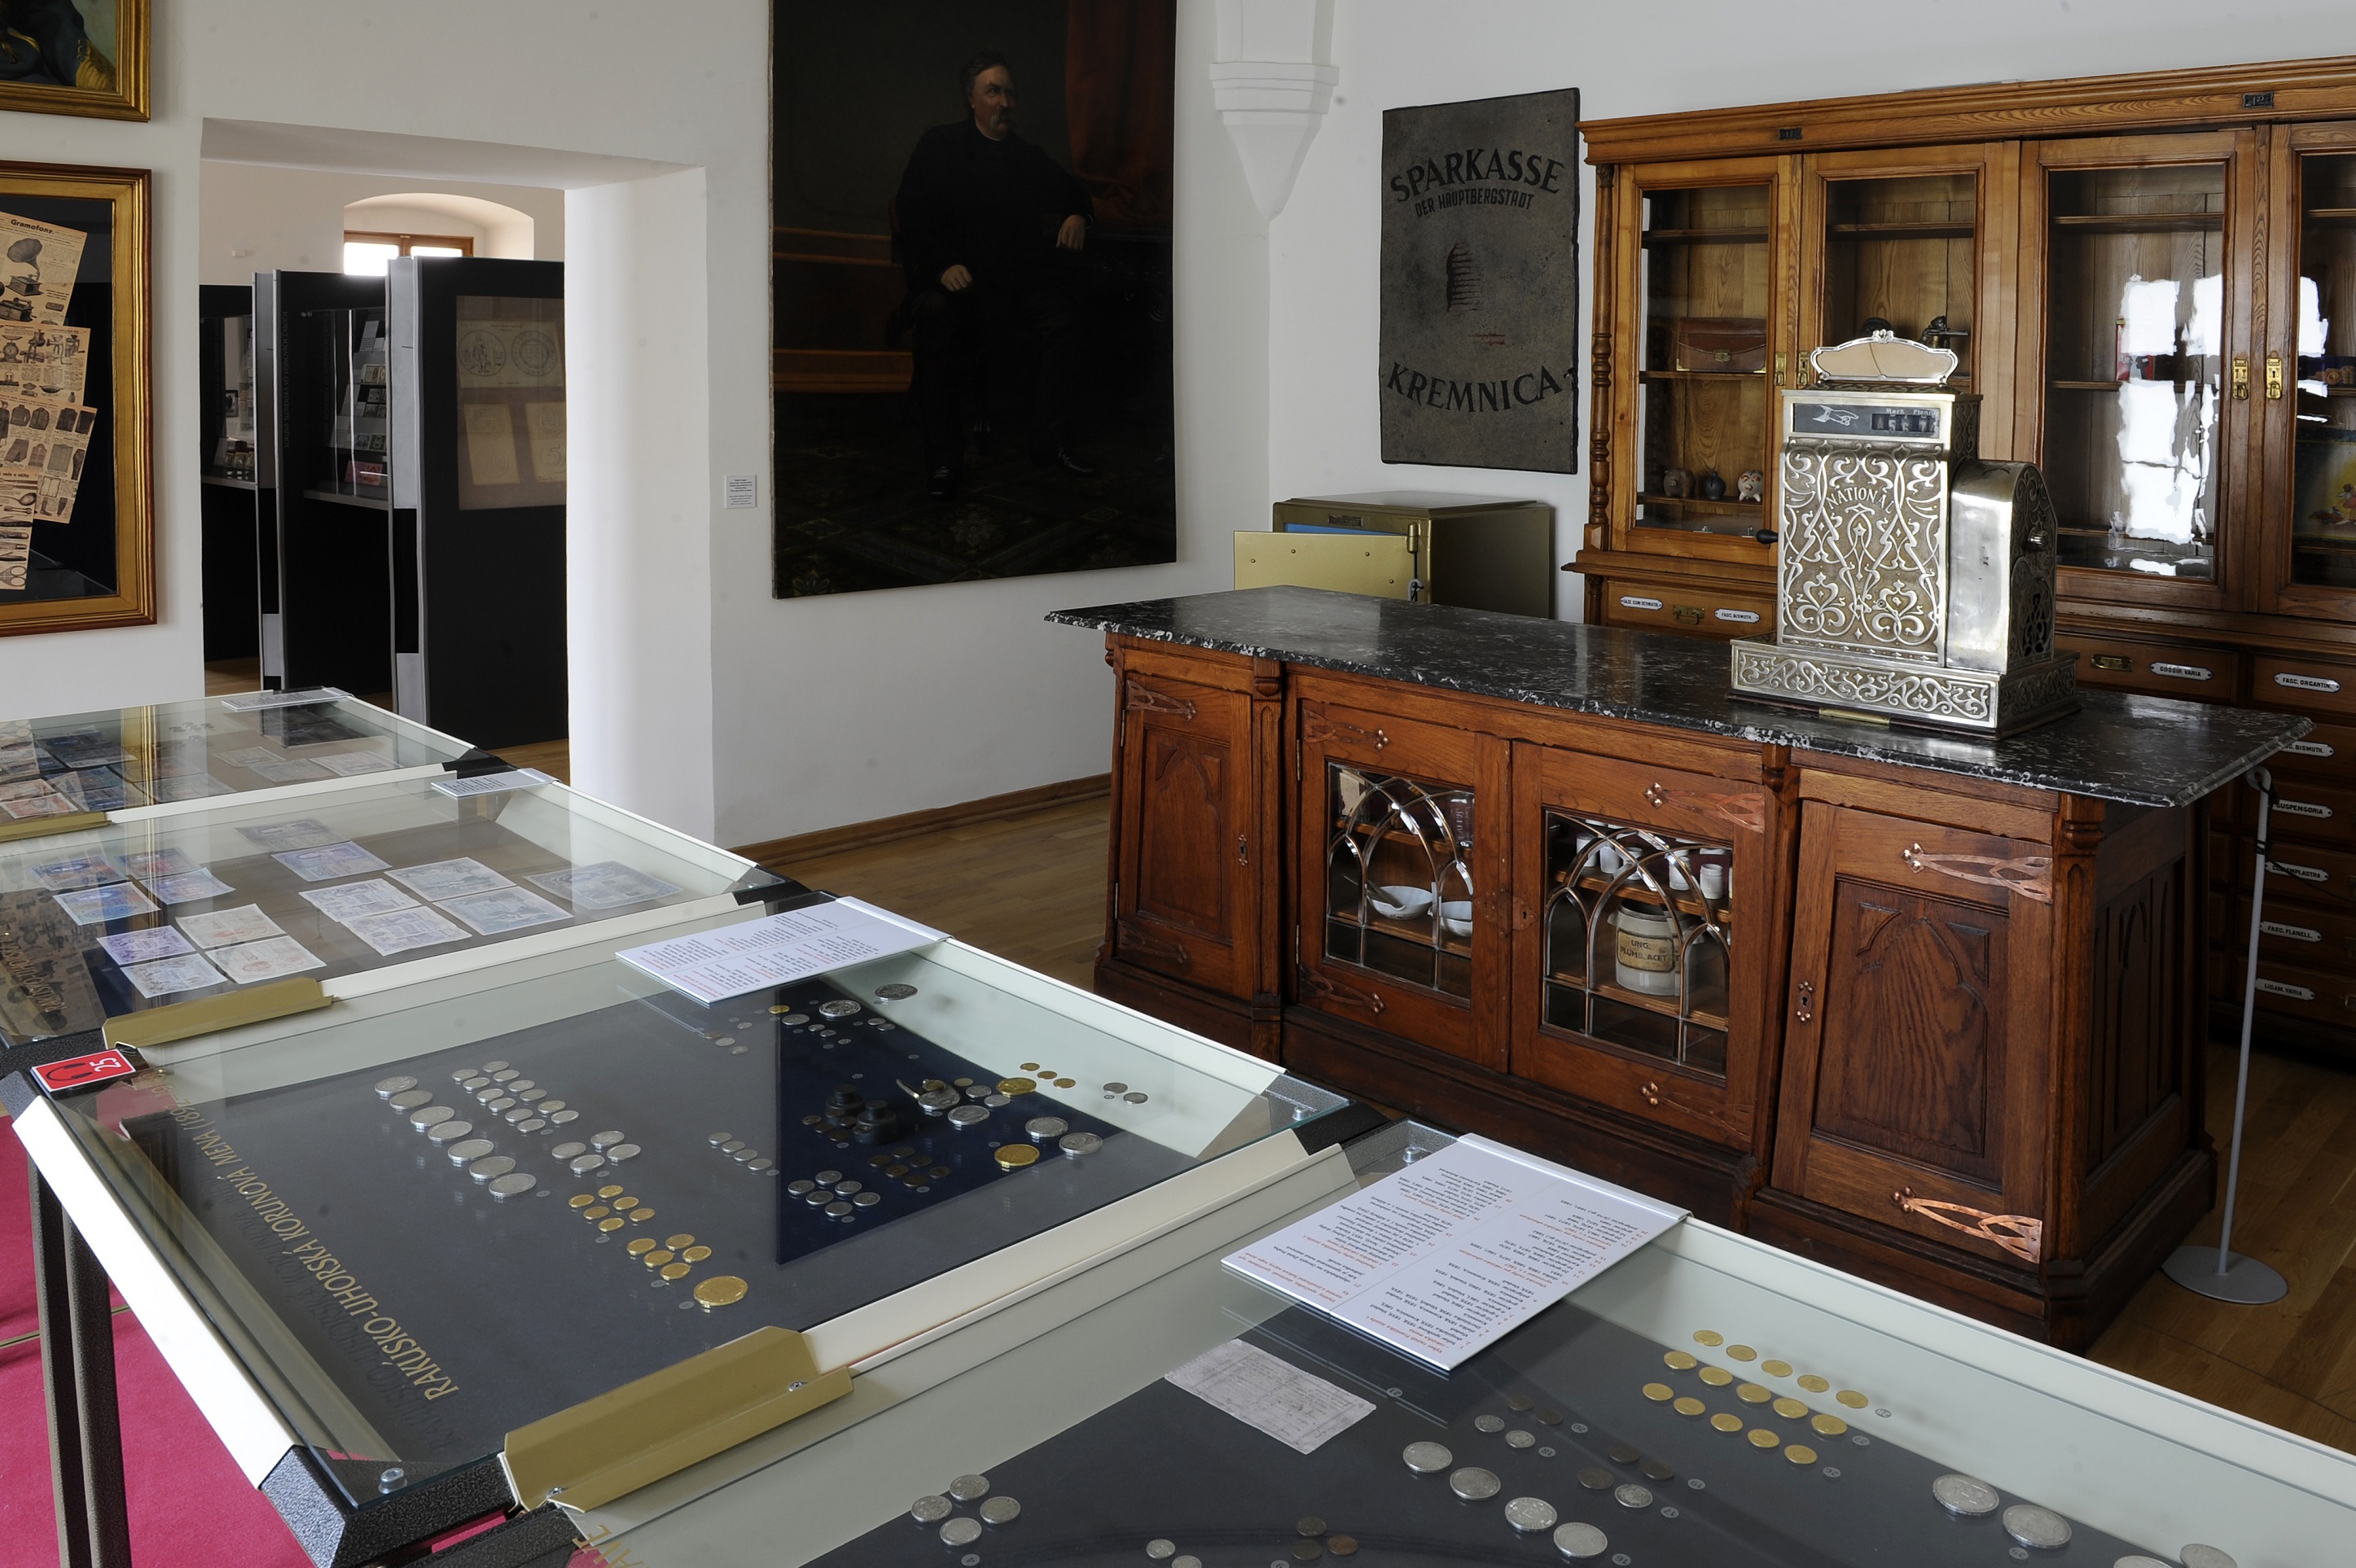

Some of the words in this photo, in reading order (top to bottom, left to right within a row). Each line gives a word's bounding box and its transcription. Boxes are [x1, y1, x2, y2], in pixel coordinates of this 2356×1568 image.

[2253, 96, 2265, 105] 12
[1391, 148, 1564, 203] SPARKASSE
[1415, 195, 1434, 218] DER
[1438, 190, 1534, 210] HAUPTBERGSTADT
[11, 218, 55, 234] Gramofony.
[1387, 362, 1562, 413] KREMNICA
[1825, 486, 1894, 515] NATIONAL
[2160, 666, 2183, 675] GOSSIP.
[2184, 668, 2201, 677] VARIA
[2282, 677, 2299, 685] FASC.
[2300, 679, 2333, 690] ORGANTIN.
[2295, 744, 2323, 753] BISMUTH.
[2276, 803, 2323, 814] SUSPENSORIA
[2268, 926, 2285, 934] FASC.
[2286, 929, 2313, 939] FLANELL.
[1631, 939, 1652, 949] UNG.
[2265, 983, 2284, 992] LIGAM.
[2285, 988, 2303, 996] VARIA
[90, 1058, 121, 1072] 25
[193, 1127, 242, 1167] MENA
[217, 1165, 309, 1242] KORUNOVÁ
[290, 1238, 459, 1401] RAKÚSKO-UHORSKÁ
